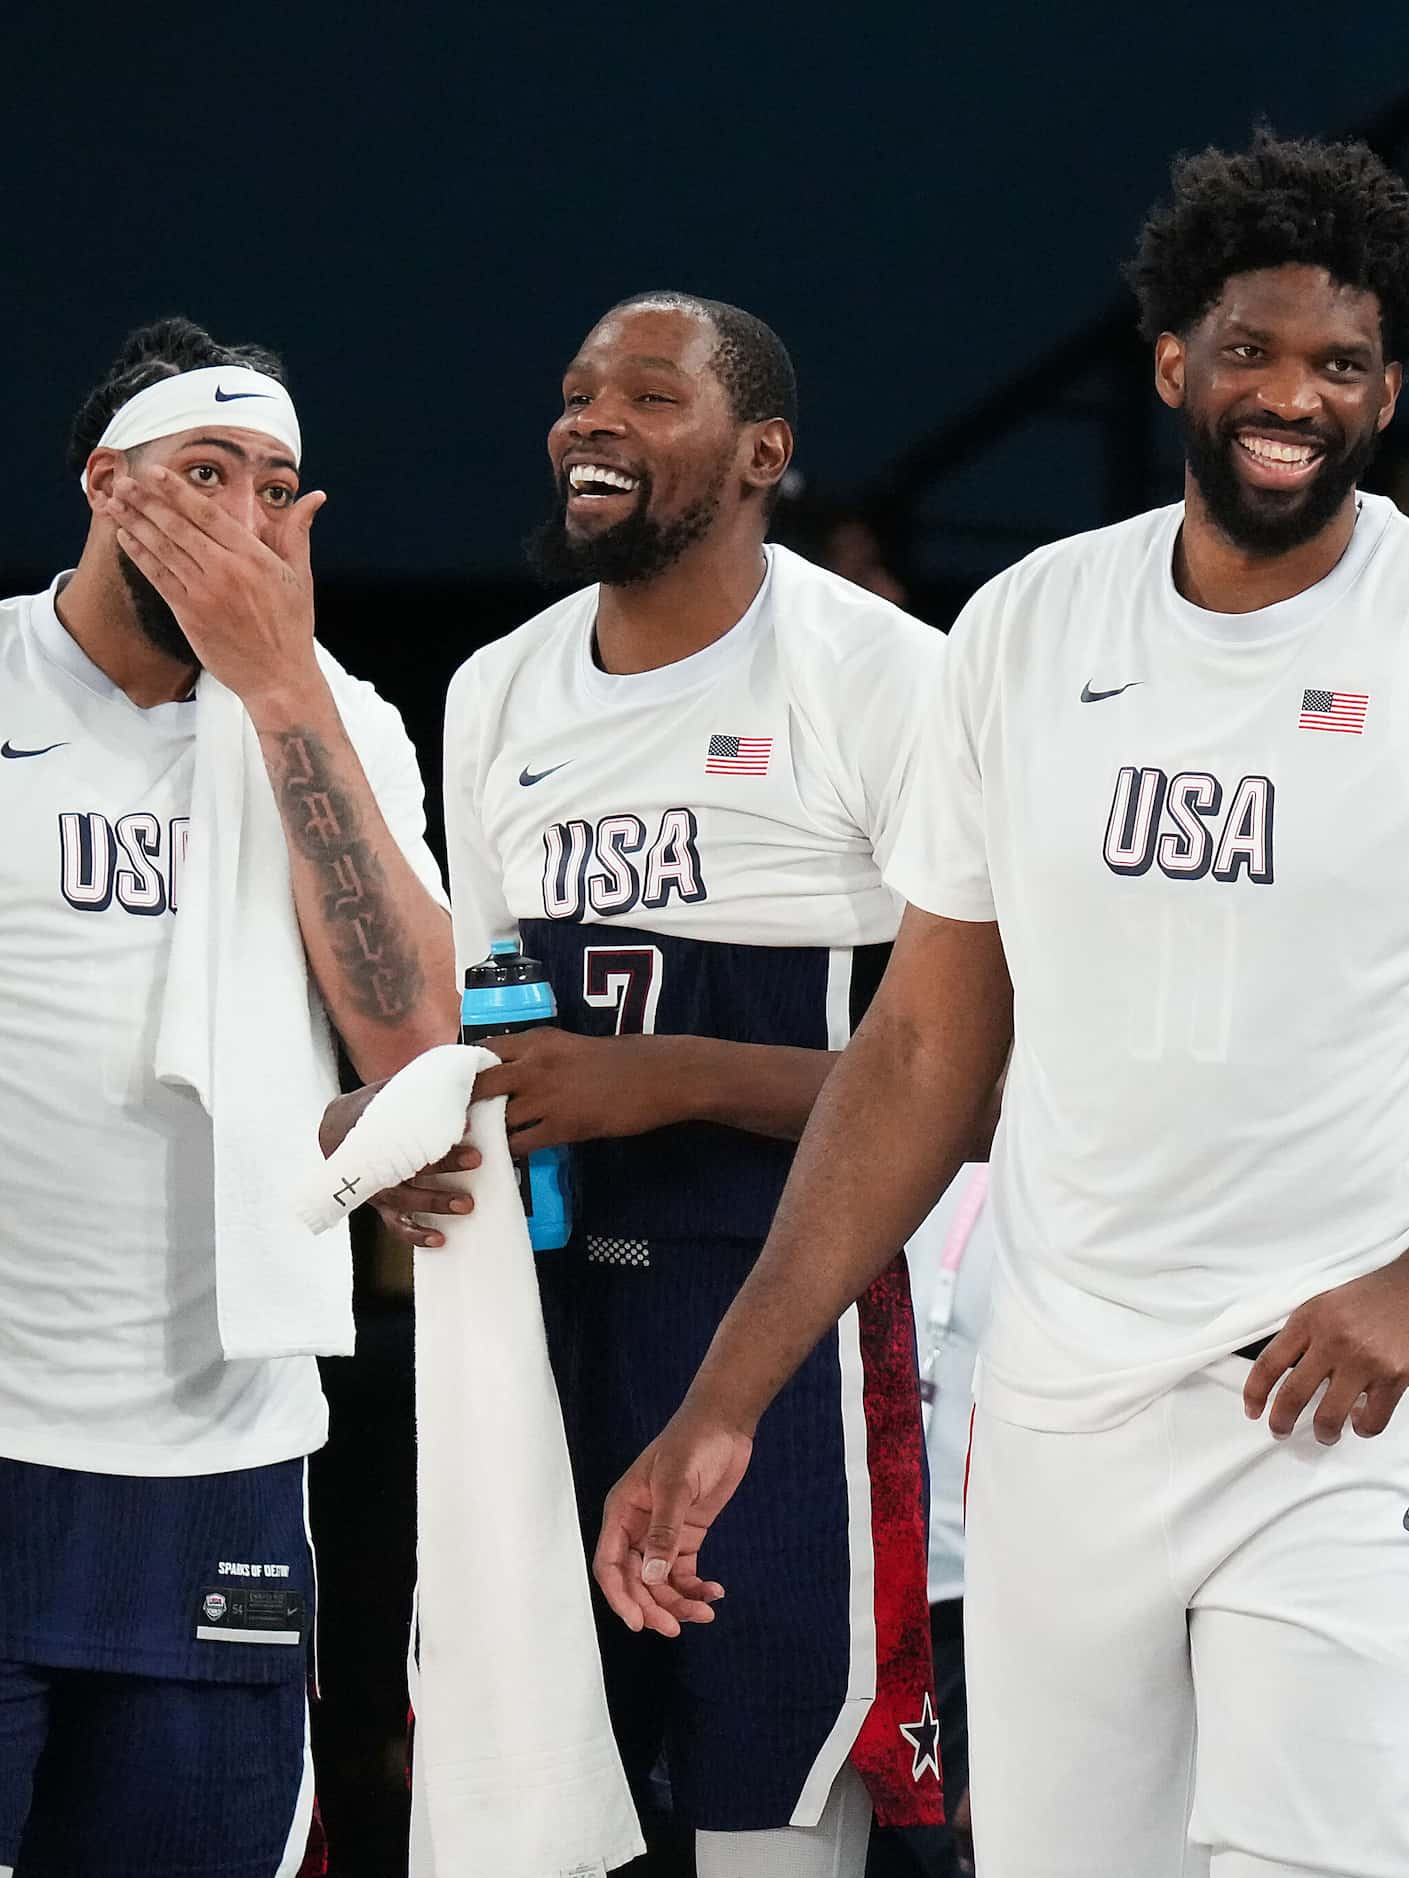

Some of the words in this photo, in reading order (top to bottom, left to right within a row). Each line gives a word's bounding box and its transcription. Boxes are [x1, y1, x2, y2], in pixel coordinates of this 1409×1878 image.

[542, 807, 708, 922] USA
[1102, 766, 1275, 884] USA
[583, 945, 664, 1036] 7
